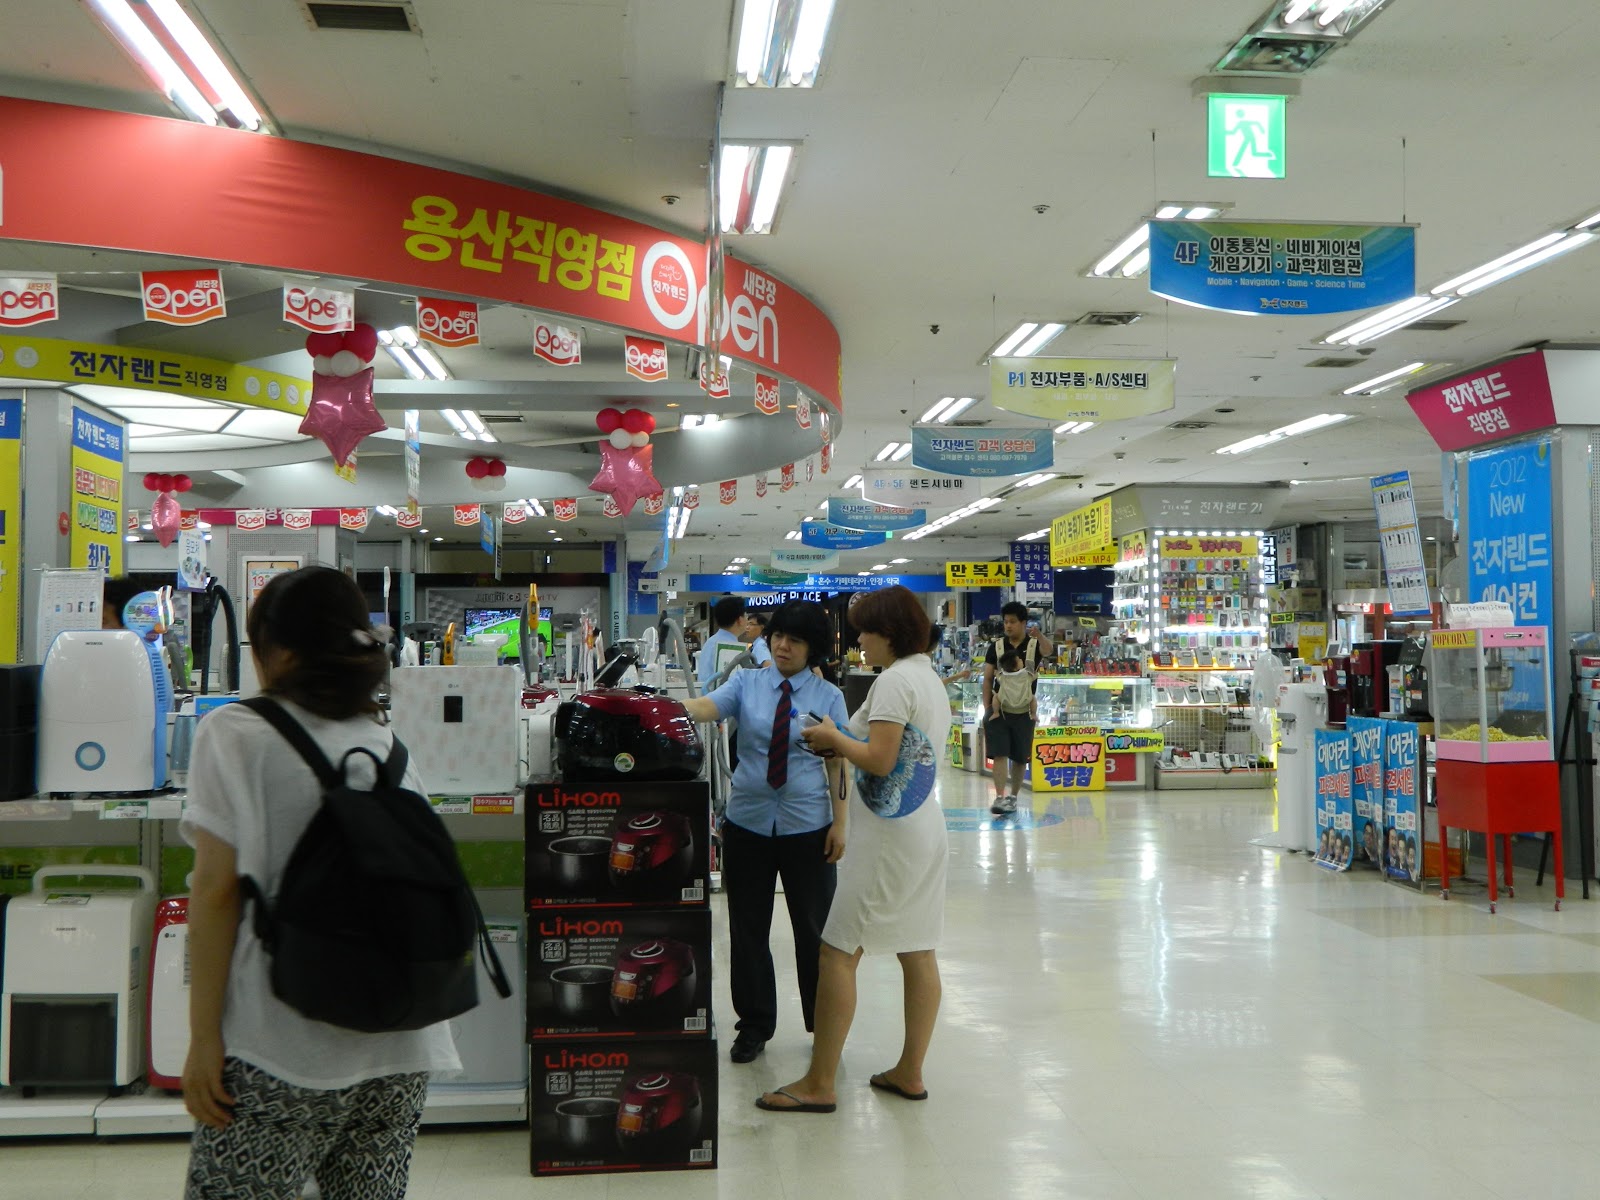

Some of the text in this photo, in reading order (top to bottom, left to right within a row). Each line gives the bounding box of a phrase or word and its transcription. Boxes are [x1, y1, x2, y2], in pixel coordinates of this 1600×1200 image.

[403, 195, 636, 301] 용산직영점
[1174, 241, 1199, 263] 4F
[1210, 237, 1361, 257] 이동통신 네비게이션
[1210, 255, 1362, 275] 게임기기 과학체험관
[195, 280, 218, 289] 새단장
[653, 280, 687, 301] 전자랜드
[743, 270, 776, 305] 새단장
[1207, 278, 1365, 288] Mobile Navigation Game Science Time
[0, 291, 54, 315] pen
[146, 283, 223, 315] Open
[287, 288, 351, 320] Open
[642, 241, 779, 364] Open
[419, 308, 477, 338] Open
[536, 325, 579, 354] Open
[627, 345, 666, 369] Open
[70, 351, 227, 391] 전자랜드 직영점
[1008, 371, 1025, 386] P1
[756, 383, 778, 404] Open
[1442, 372, 1511, 414] 전자랜드
[1467, 406, 1511, 435] 직영점
[77, 418, 106, 448] 전자랜드
[931, 439, 1036, 452] 전자랜드 고객 상담실
[1490, 455, 1526, 488] 2012
[720, 488, 737, 500] Open
[1490, 491, 1526, 518] New
[398, 511, 421, 523] Open
[455, 509, 479, 521] Open
[505, 506, 526, 518] Open
[555, 504, 576, 516] Open
[1200, 501, 1248, 514] 전자랜드
[181, 516, 199, 526] pen
[237, 514, 264, 525] Open
[285, 514, 311, 525] Open
[341, 513, 366, 525] Open
[1057, 556, 1086, 564] 자사전
[1472, 533, 1549, 575] 전자랜드
[252, 576, 264, 586] 13
[951, 564, 1011, 577] 만복사
[749, 594, 786, 606] WOSOME
[1432, 633, 1468, 646] POPCORN
[1107, 735, 1132, 750] PMP
[1353, 727, 1381, 759] 에어컨
[1387, 730, 1414, 765] 어컨
[1318, 739, 1350, 771] 에어컨
[1319, 773, 1350, 798] 파격세일
